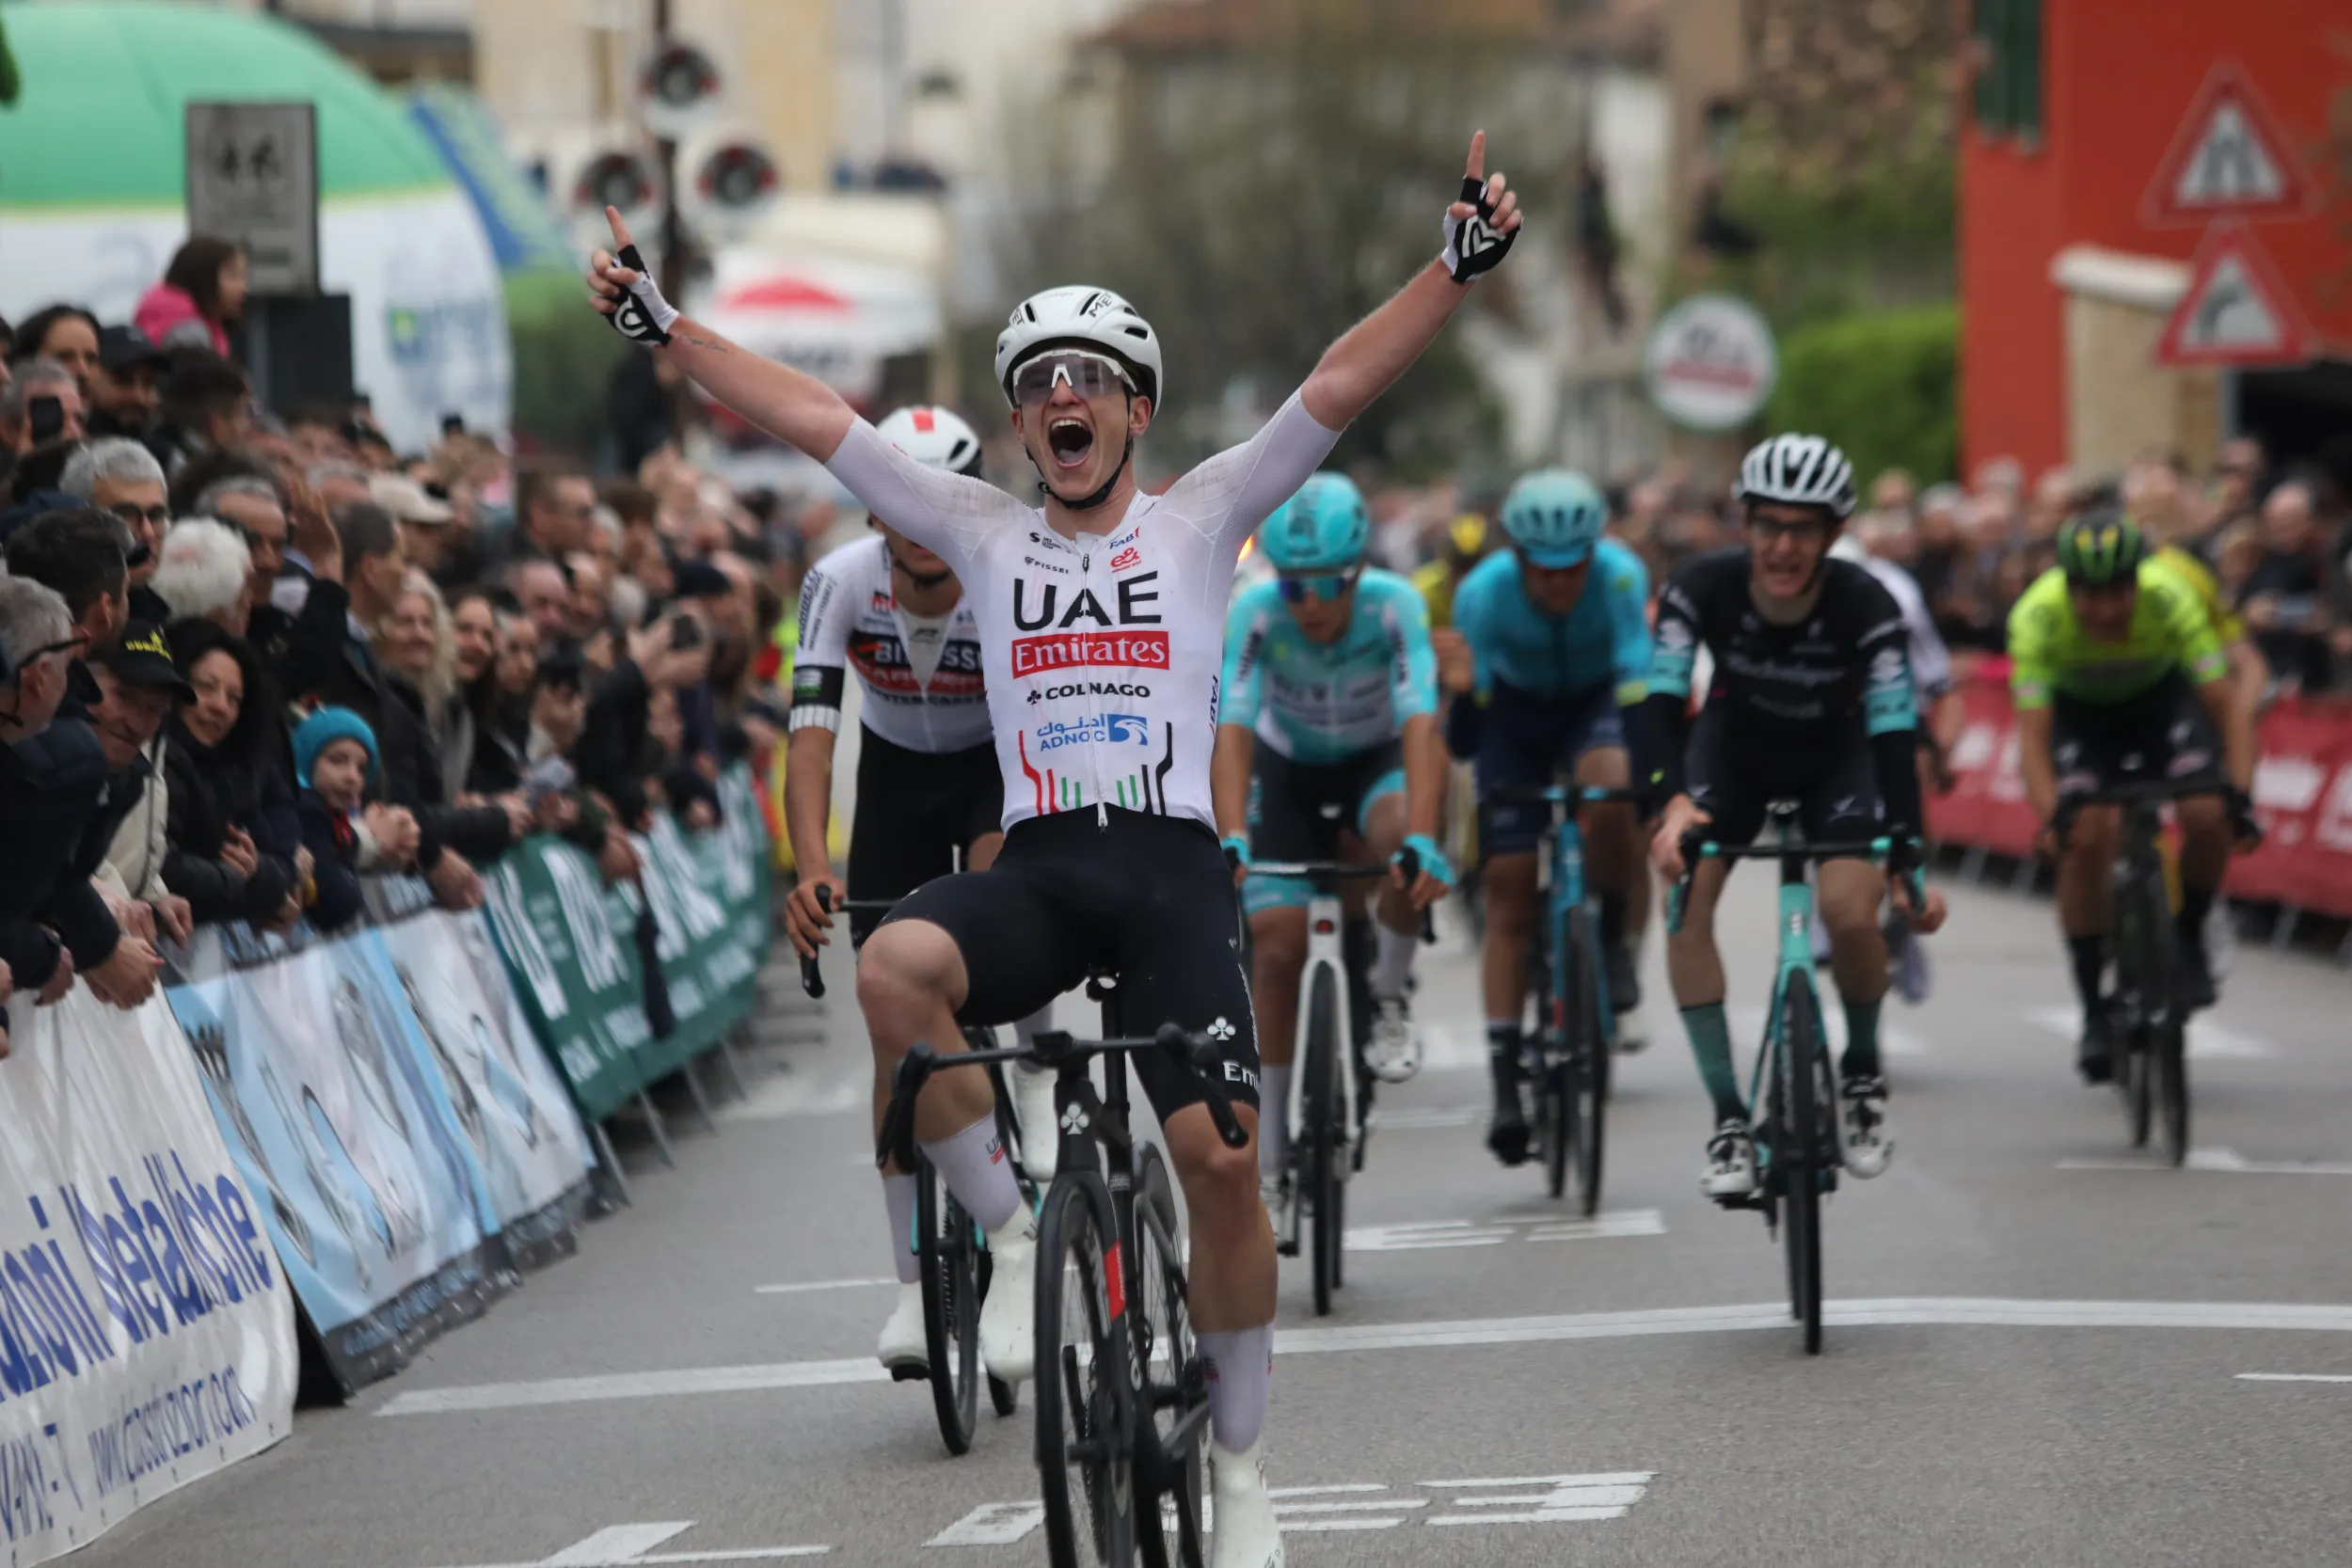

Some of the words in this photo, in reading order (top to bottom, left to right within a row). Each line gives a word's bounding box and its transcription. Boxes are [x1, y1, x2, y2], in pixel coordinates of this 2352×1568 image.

[1034, 561, 1070, 575] PISSEI
[1013, 570, 1163, 632] UAE
[874, 640, 983, 671] BISS
[1014, 637, 1166, 673] Emirates
[1044, 682, 1151, 701] COLNAGO
[1040, 730, 1106, 752] ADNOC
